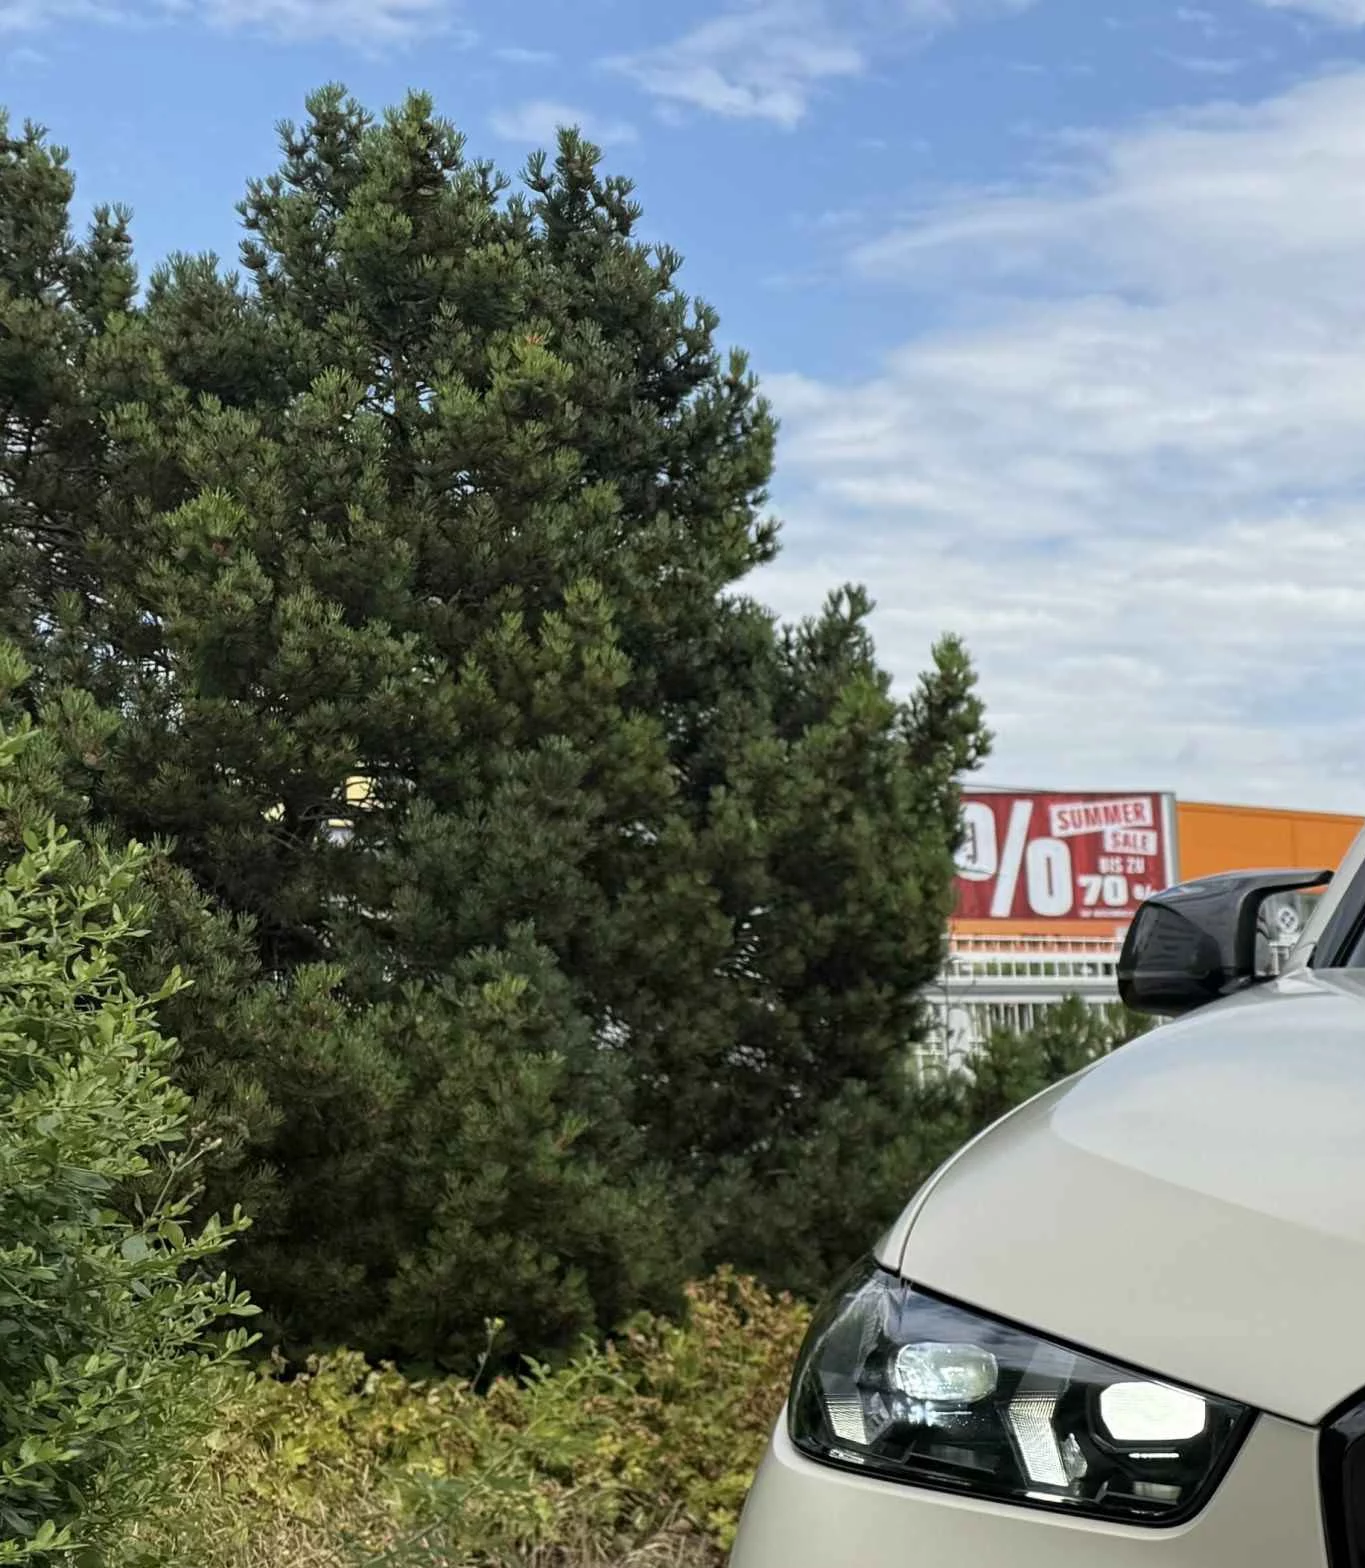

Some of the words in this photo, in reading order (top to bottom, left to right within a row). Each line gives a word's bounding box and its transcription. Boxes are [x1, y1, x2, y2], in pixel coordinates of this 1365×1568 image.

[1057, 801, 1147, 831] SUMMER
[1111, 830, 1149, 852] SALE
[1077, 875, 1129, 908] 70
